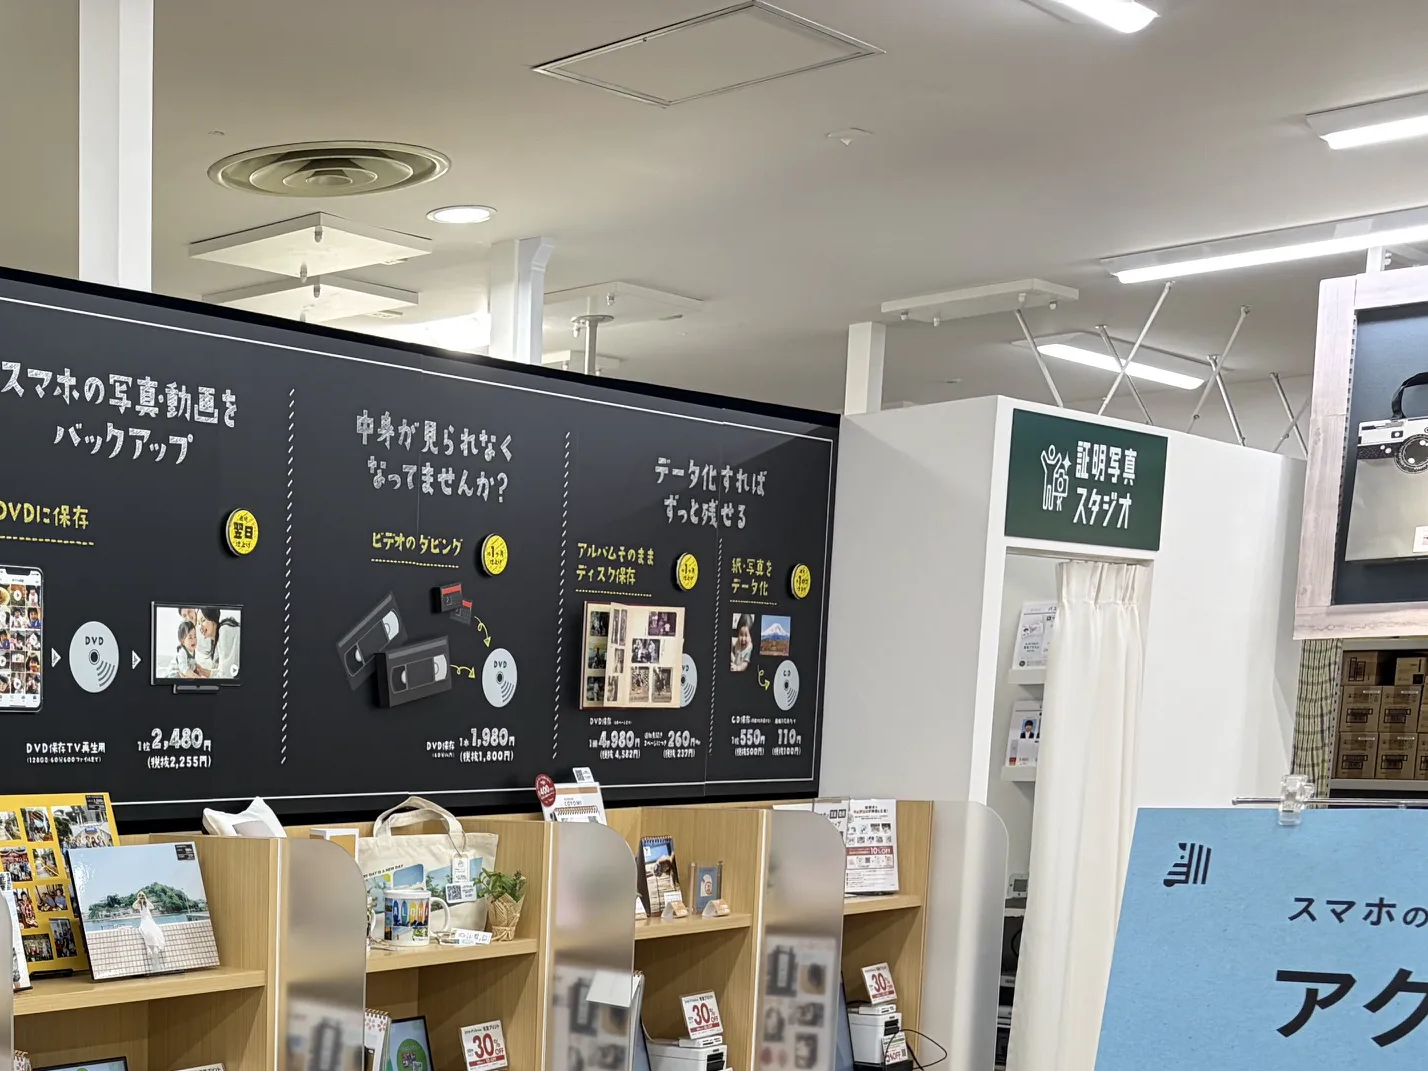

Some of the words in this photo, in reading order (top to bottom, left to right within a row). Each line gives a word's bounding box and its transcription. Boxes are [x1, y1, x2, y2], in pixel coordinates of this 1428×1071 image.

[53, 422, 194, 464] バックアップ
[356, 409, 512, 462] 中身が見られなく
[654, 457, 768, 497] データ化すれば
[1075, 441, 1137, 486] 証明写真
[367, 455, 508, 503] なってませんか?
[664, 494, 746, 529] ずっと残せる
[1073, 487, 1132, 529] スタジオ
[576, 542, 655, 565] アルバムそのまま
[576, 565, 636, 585] ディスク保存
[732, 578, 768, 596] データ化
[85, 636, 104, 646] DVD
[493, 660, 507, 669] DVD
[26, 742, 106, 754] DVD保存TV再生用
[151, 728, 212, 752] 2,480円
[147, 755, 211, 769] (税抜2,255円)
[1288, 896, 1428, 927] スマホの
[1276, 967, 1428, 1048] アク
[495, 1047, 504, 1055] OFF
